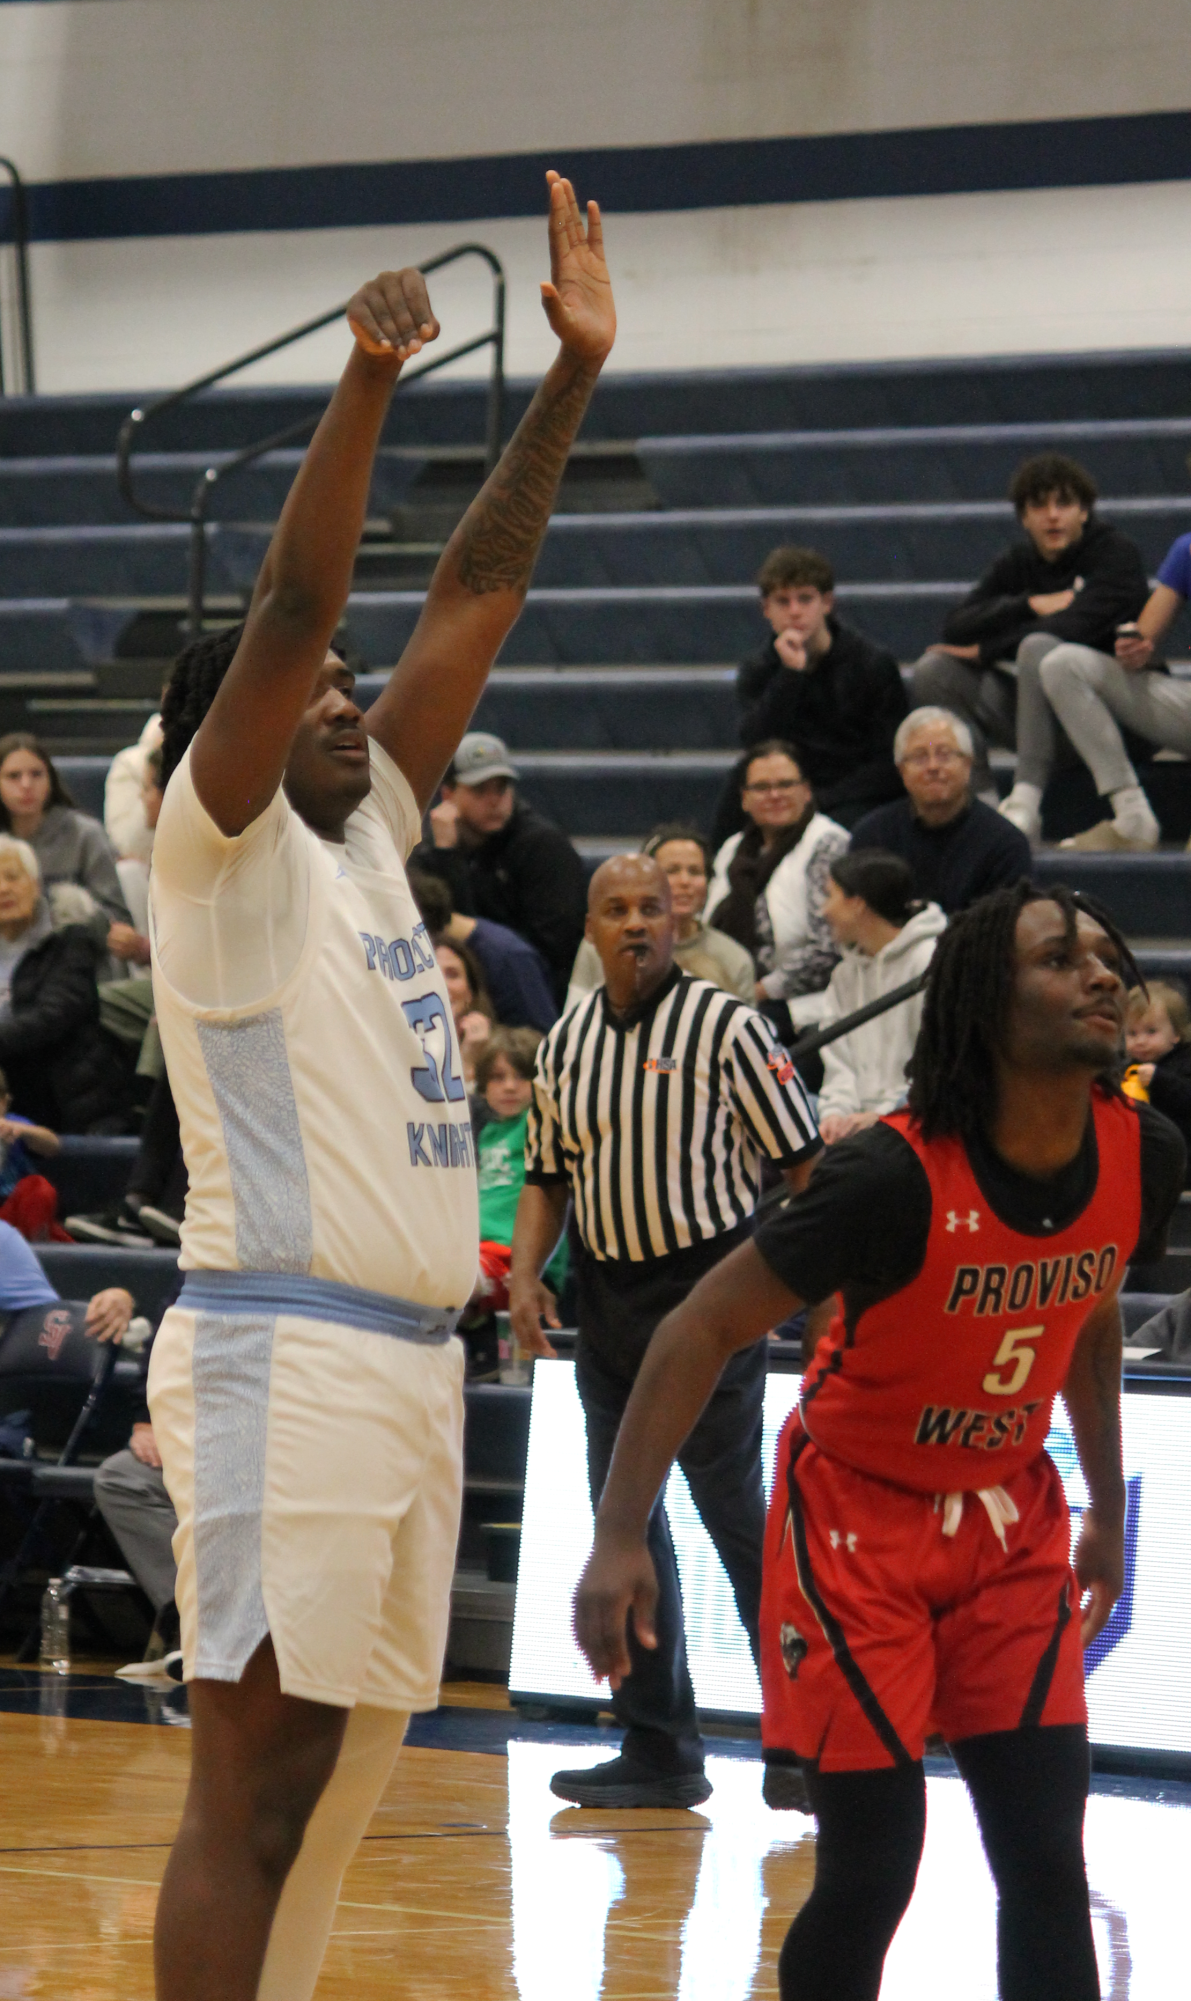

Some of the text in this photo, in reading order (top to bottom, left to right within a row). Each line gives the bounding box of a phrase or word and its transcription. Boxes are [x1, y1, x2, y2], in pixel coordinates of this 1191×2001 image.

[944, 1243, 1118, 1317] PROVISO
[982, 1324, 1046, 1396] 5
[914, 1399, 1043, 1452] WEST
